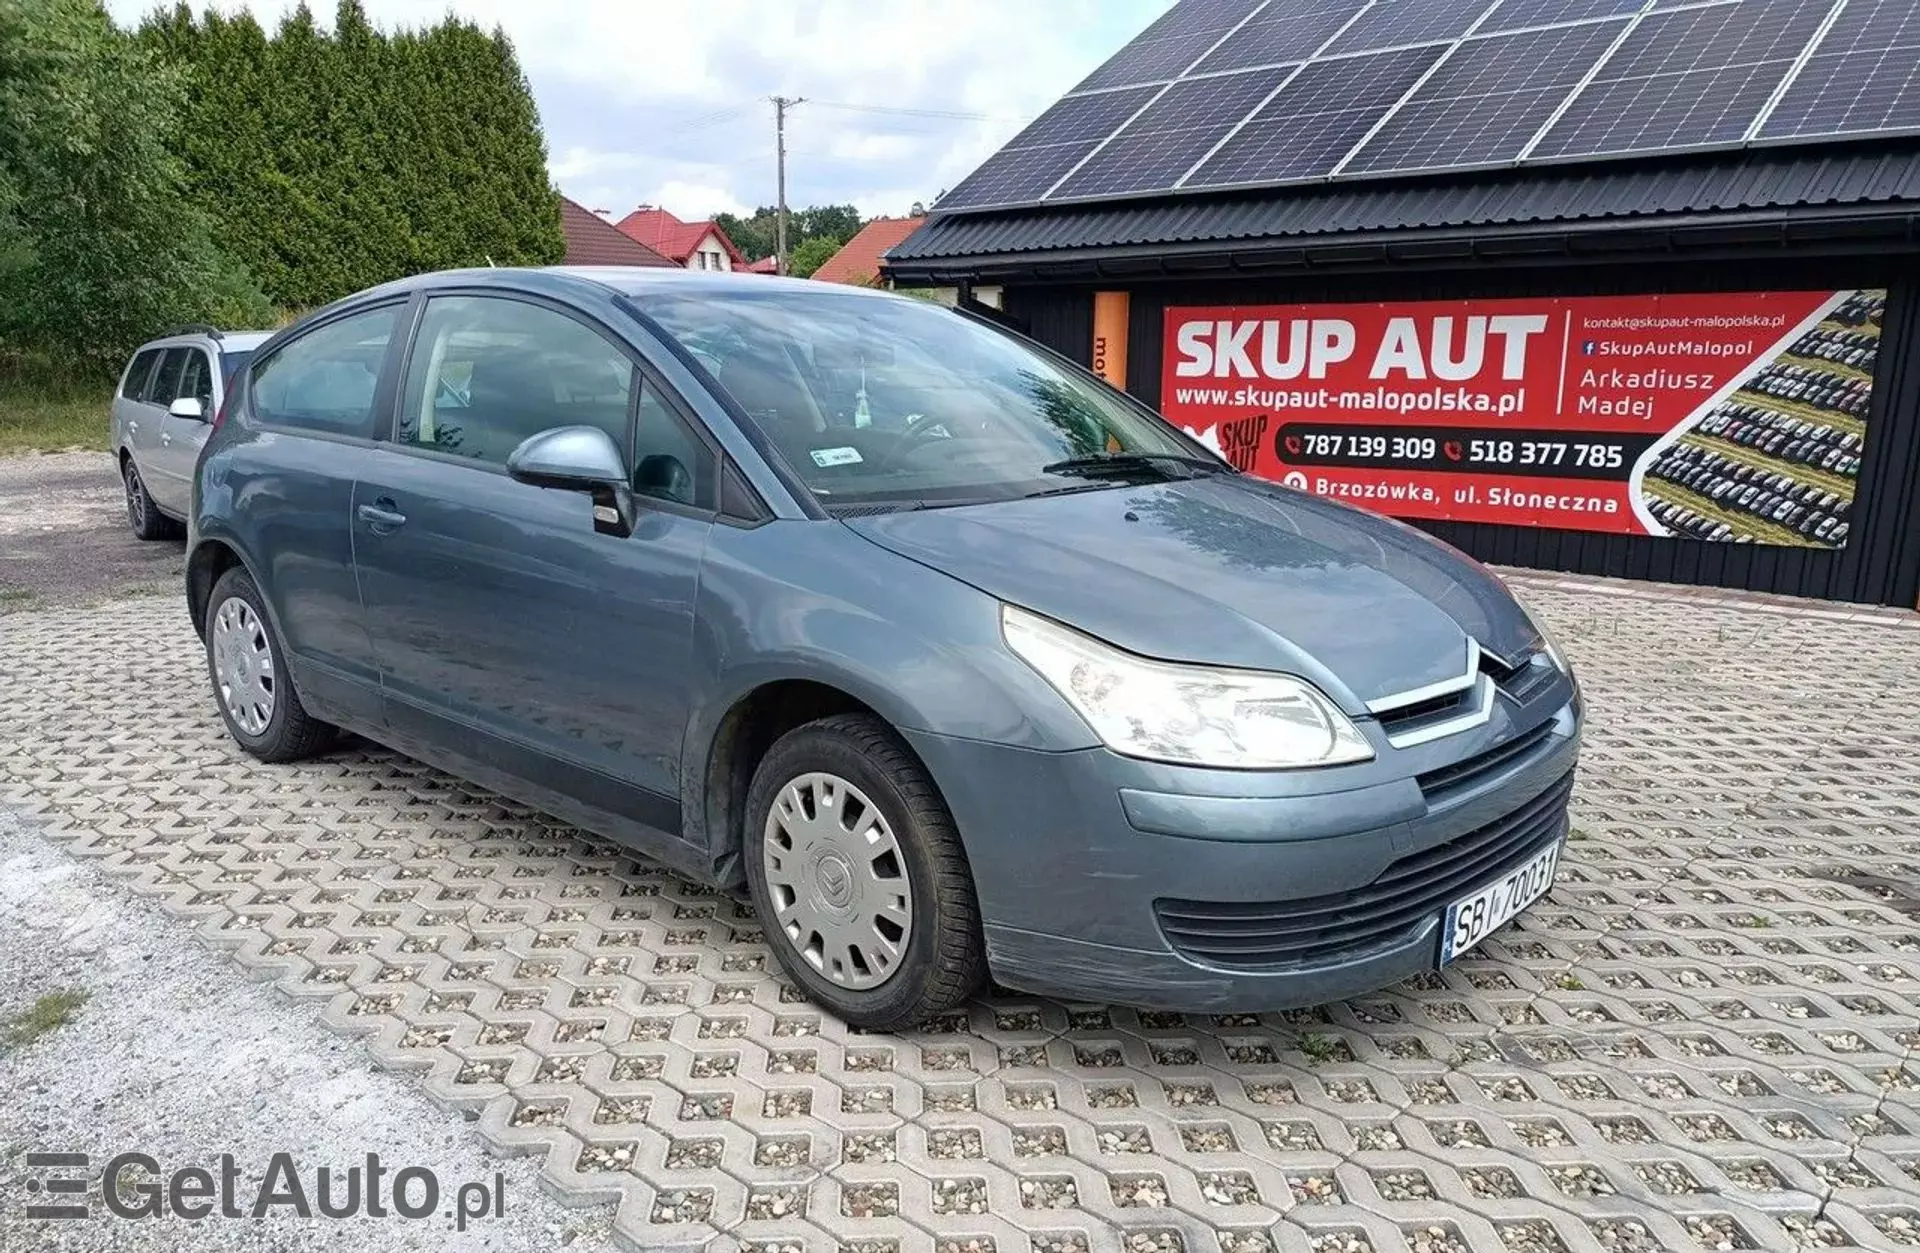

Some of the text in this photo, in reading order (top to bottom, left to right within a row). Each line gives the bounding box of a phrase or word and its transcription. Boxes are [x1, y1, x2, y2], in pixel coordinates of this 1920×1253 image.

[1583, 313, 1785, 330] kontakt@skupaut-malopolska.pl
[1176, 315, 1549, 380] SKUP AUT
[1599, 340, 1753, 357] SkupAutMalopol
[1580, 367, 1715, 390] Arkadiusz
[1175, 385, 1526, 416] www.skupaut-malopolska.pl
[1577, 395, 1654, 420] Madej
[1222, 414, 1268, 452] SKUP
[1303, 434, 1436, 459] 787 139 309
[1469, 440, 1623, 468] 518 377 785
[1316, 478, 1619, 513] Brzozówka, ul. Słoneczna
[1455, 847, 1556, 949] SBI 70031
